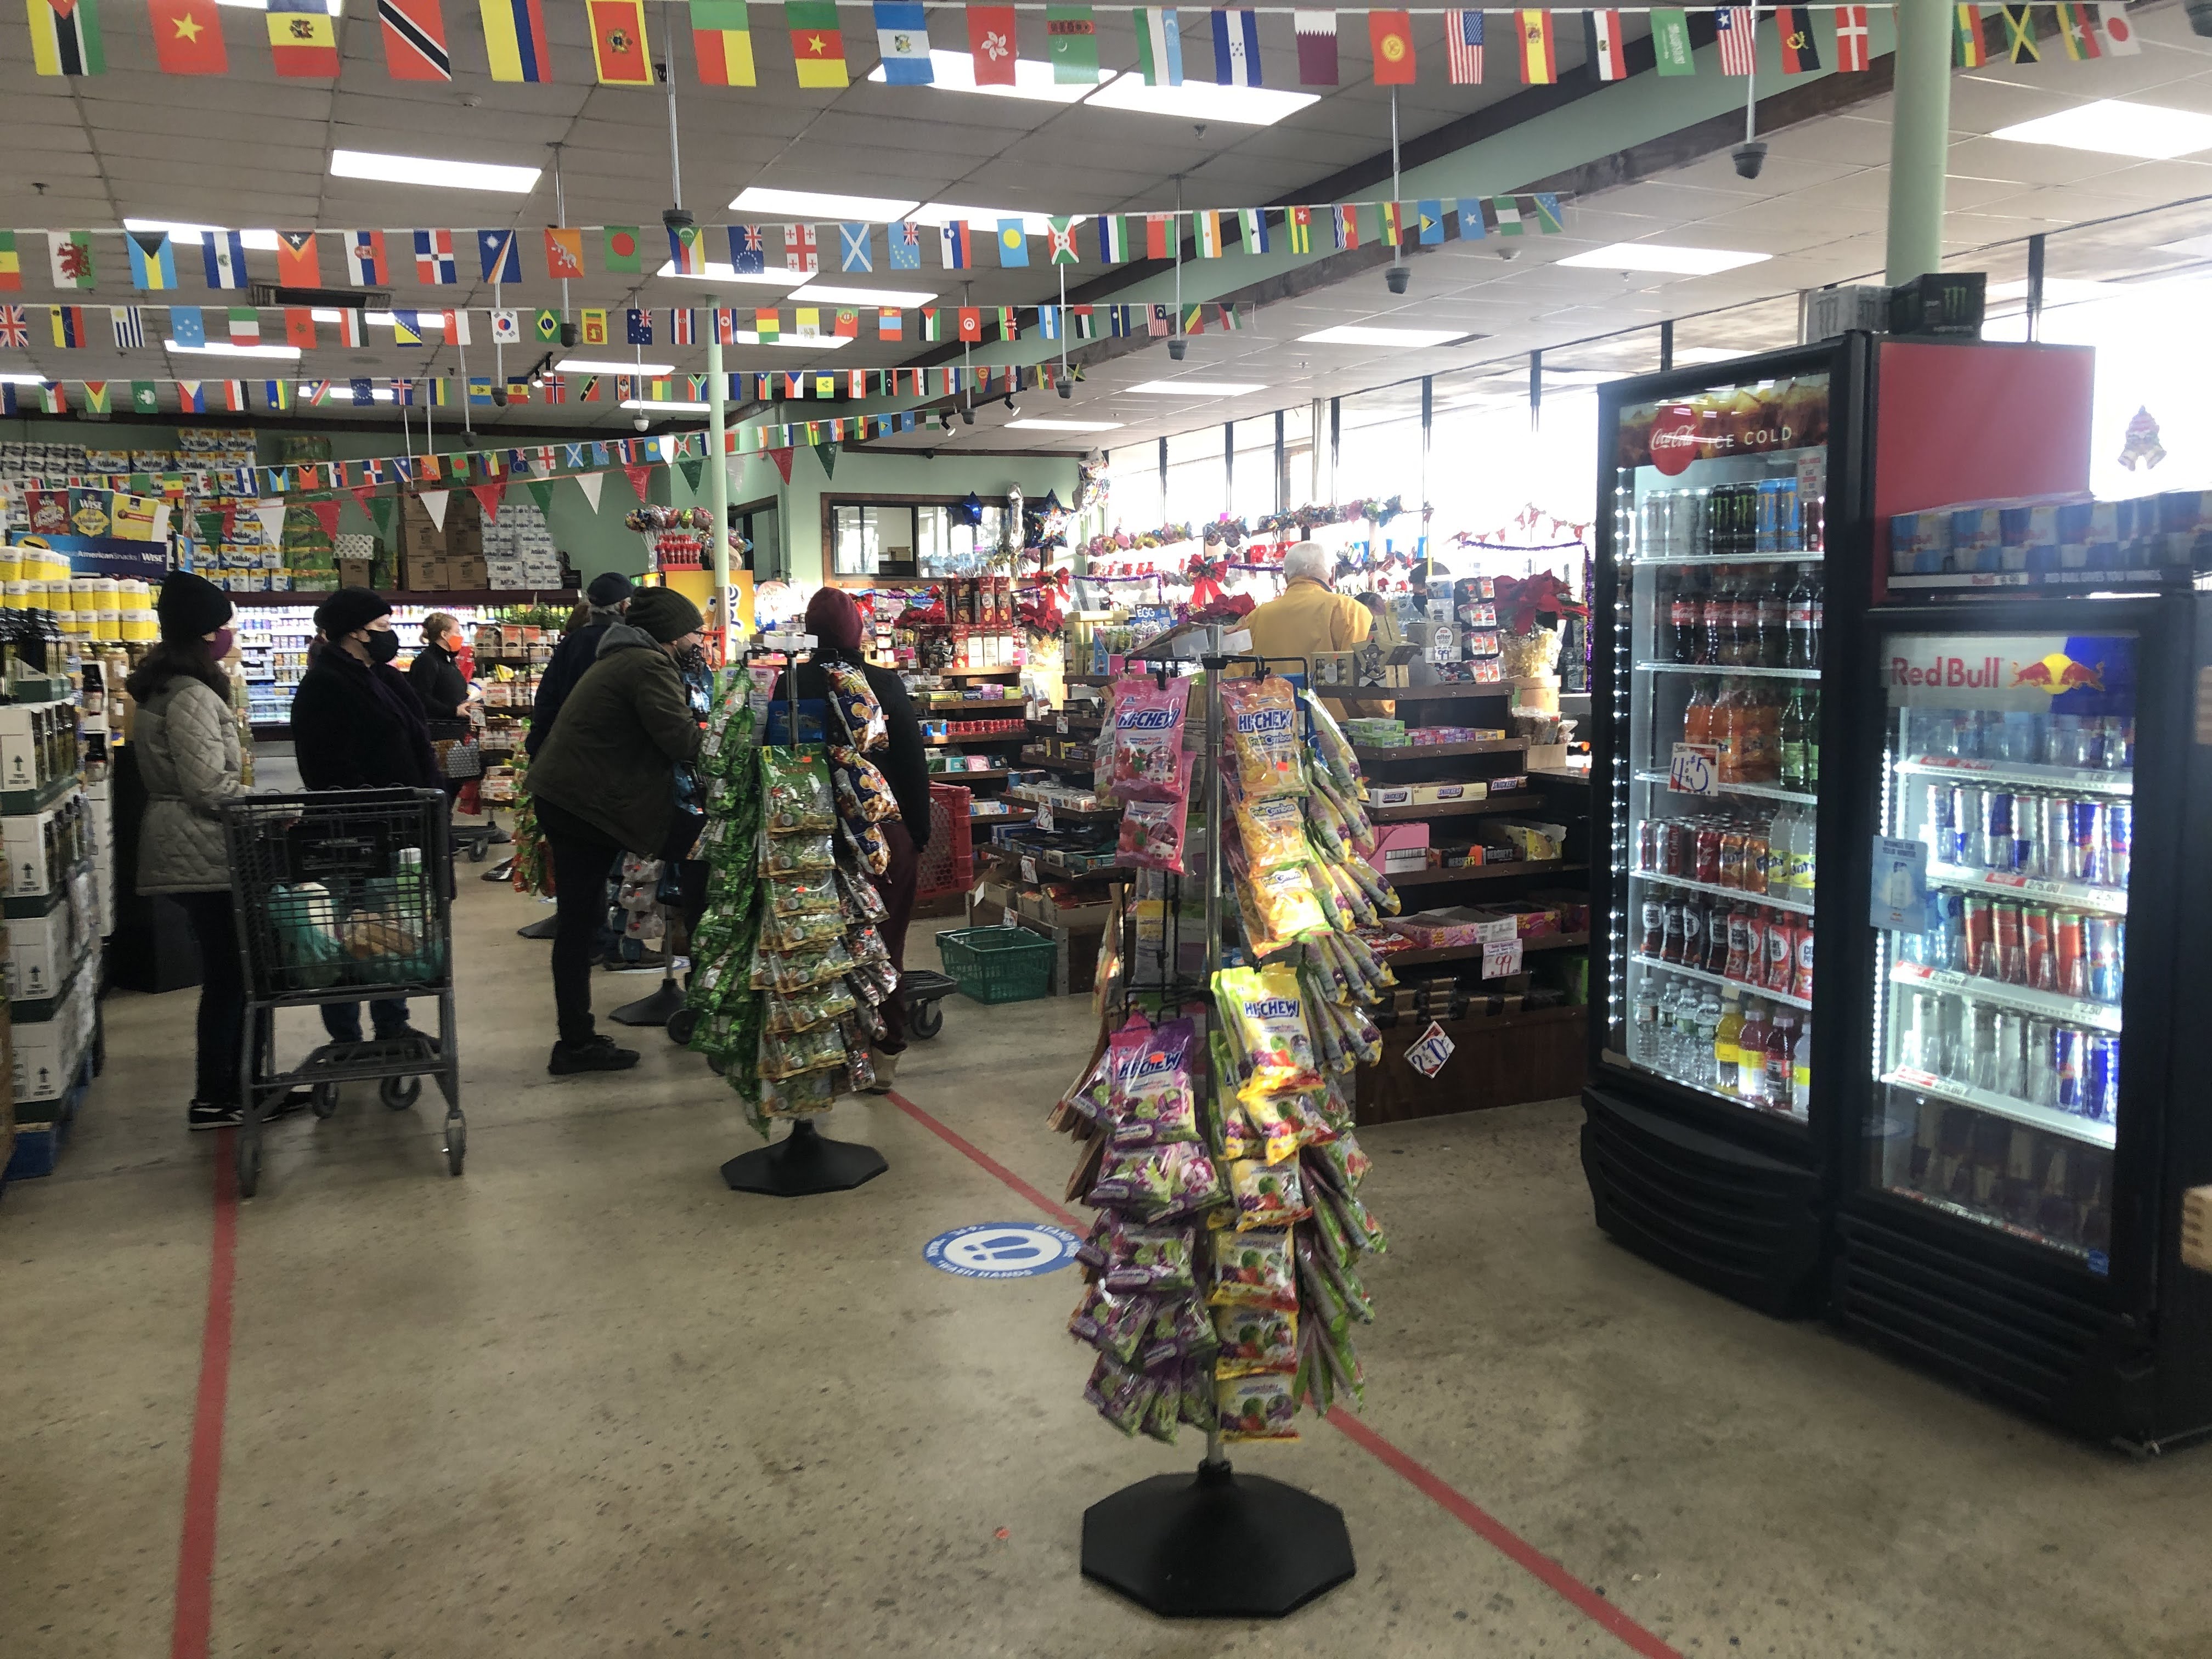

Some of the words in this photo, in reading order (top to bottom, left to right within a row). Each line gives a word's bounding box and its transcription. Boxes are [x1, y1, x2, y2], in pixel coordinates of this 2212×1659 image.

[1708, 434, 1735, 449] ICE
[1744, 426, 1792, 445] COLD
[79, 499, 103, 510] WISE
[141, 552, 163, 562] WISE
[1891, 657, 1943, 687] Red
[1948, 657, 2001, 688] Bull
[1118, 708, 1180, 729] HI-CHEW
[1238, 709, 1293, 733] HI-CHEW
[1384, 792, 1406, 802] SNICKERS
[1438, 787, 1462, 796] SNICKERS
[1243, 999, 1300, 1019] HI-CHEW
